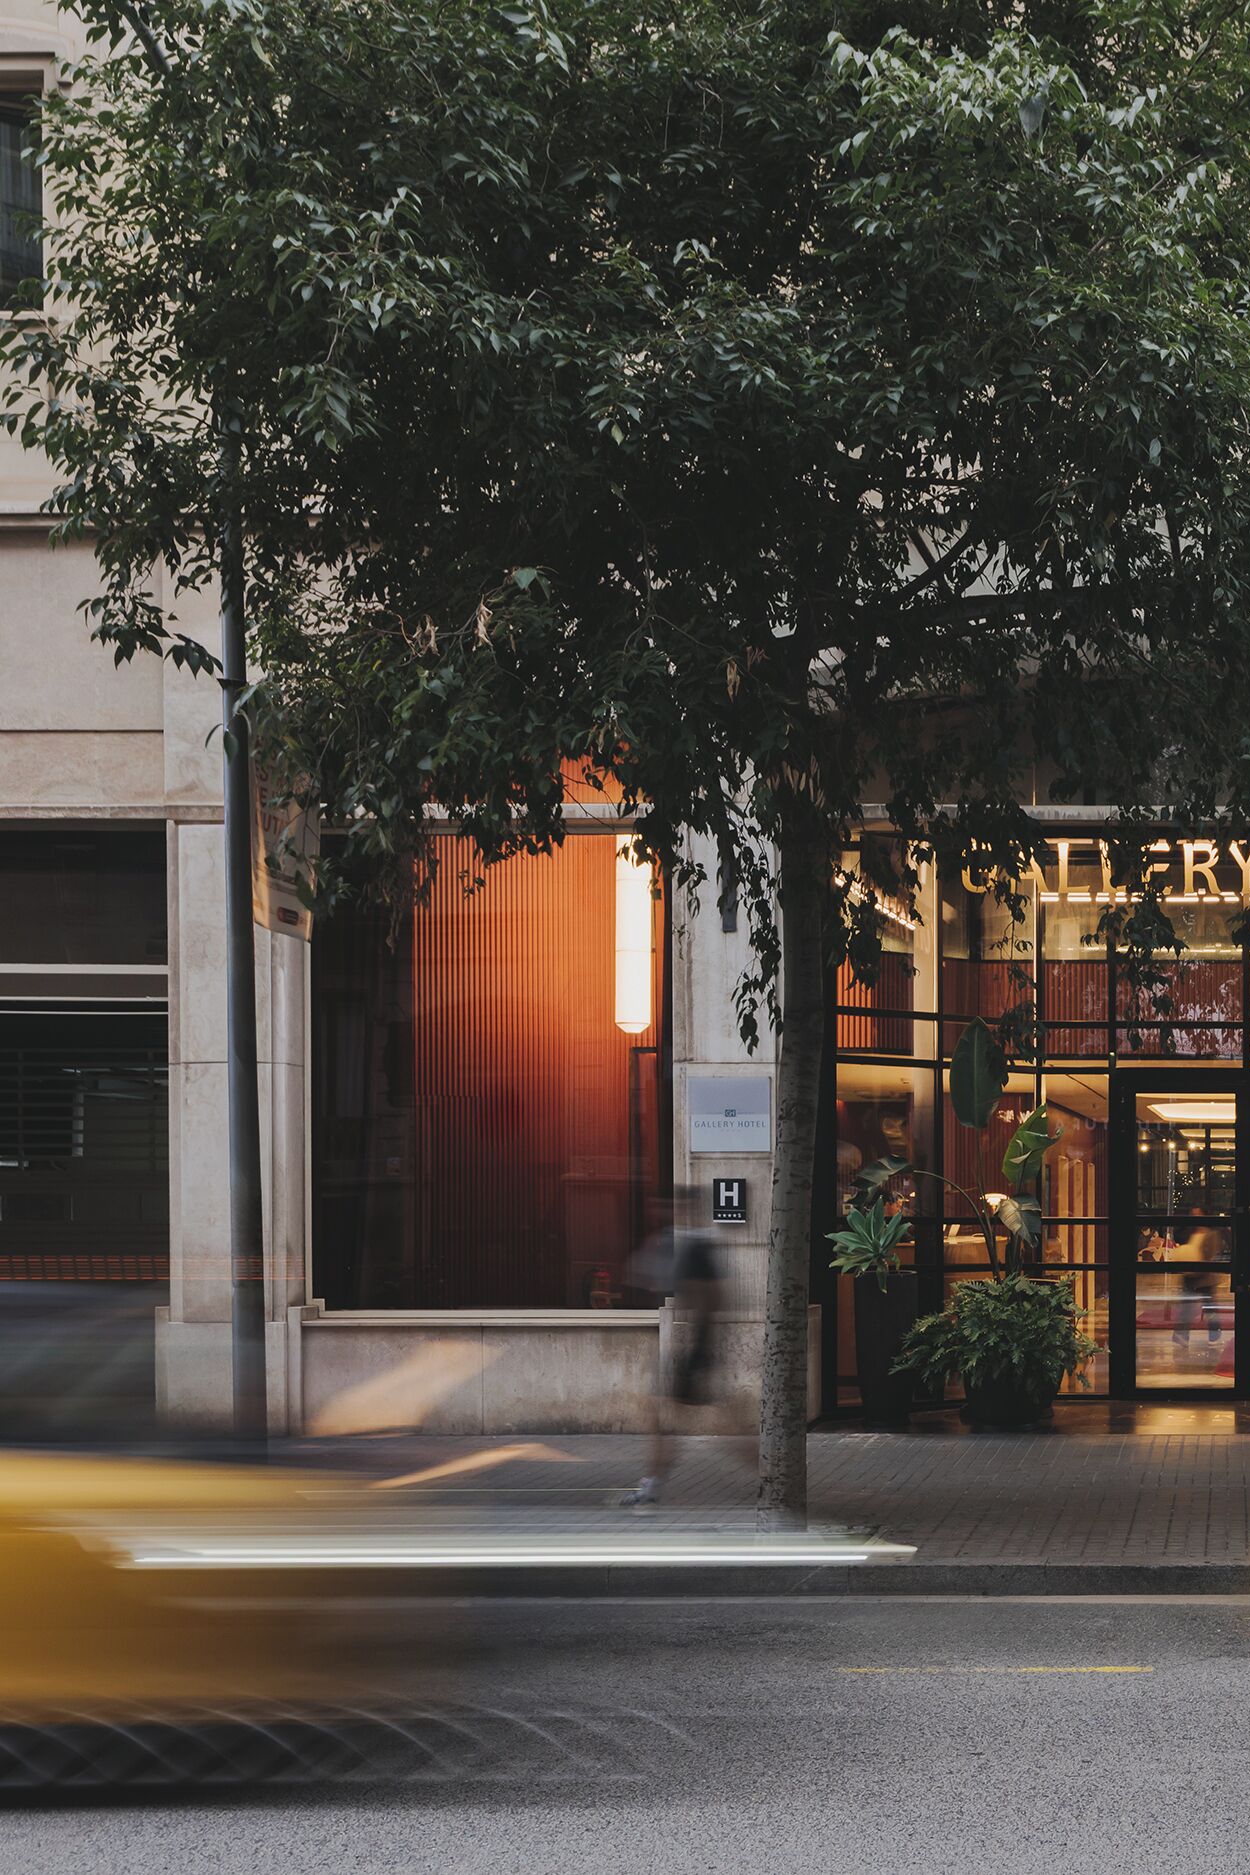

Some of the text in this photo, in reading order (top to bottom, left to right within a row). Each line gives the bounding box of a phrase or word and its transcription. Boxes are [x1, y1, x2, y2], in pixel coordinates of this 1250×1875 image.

[695, 1120, 766, 1128] GALLERY HOTEL
[720, 1182, 739, 1207] H
